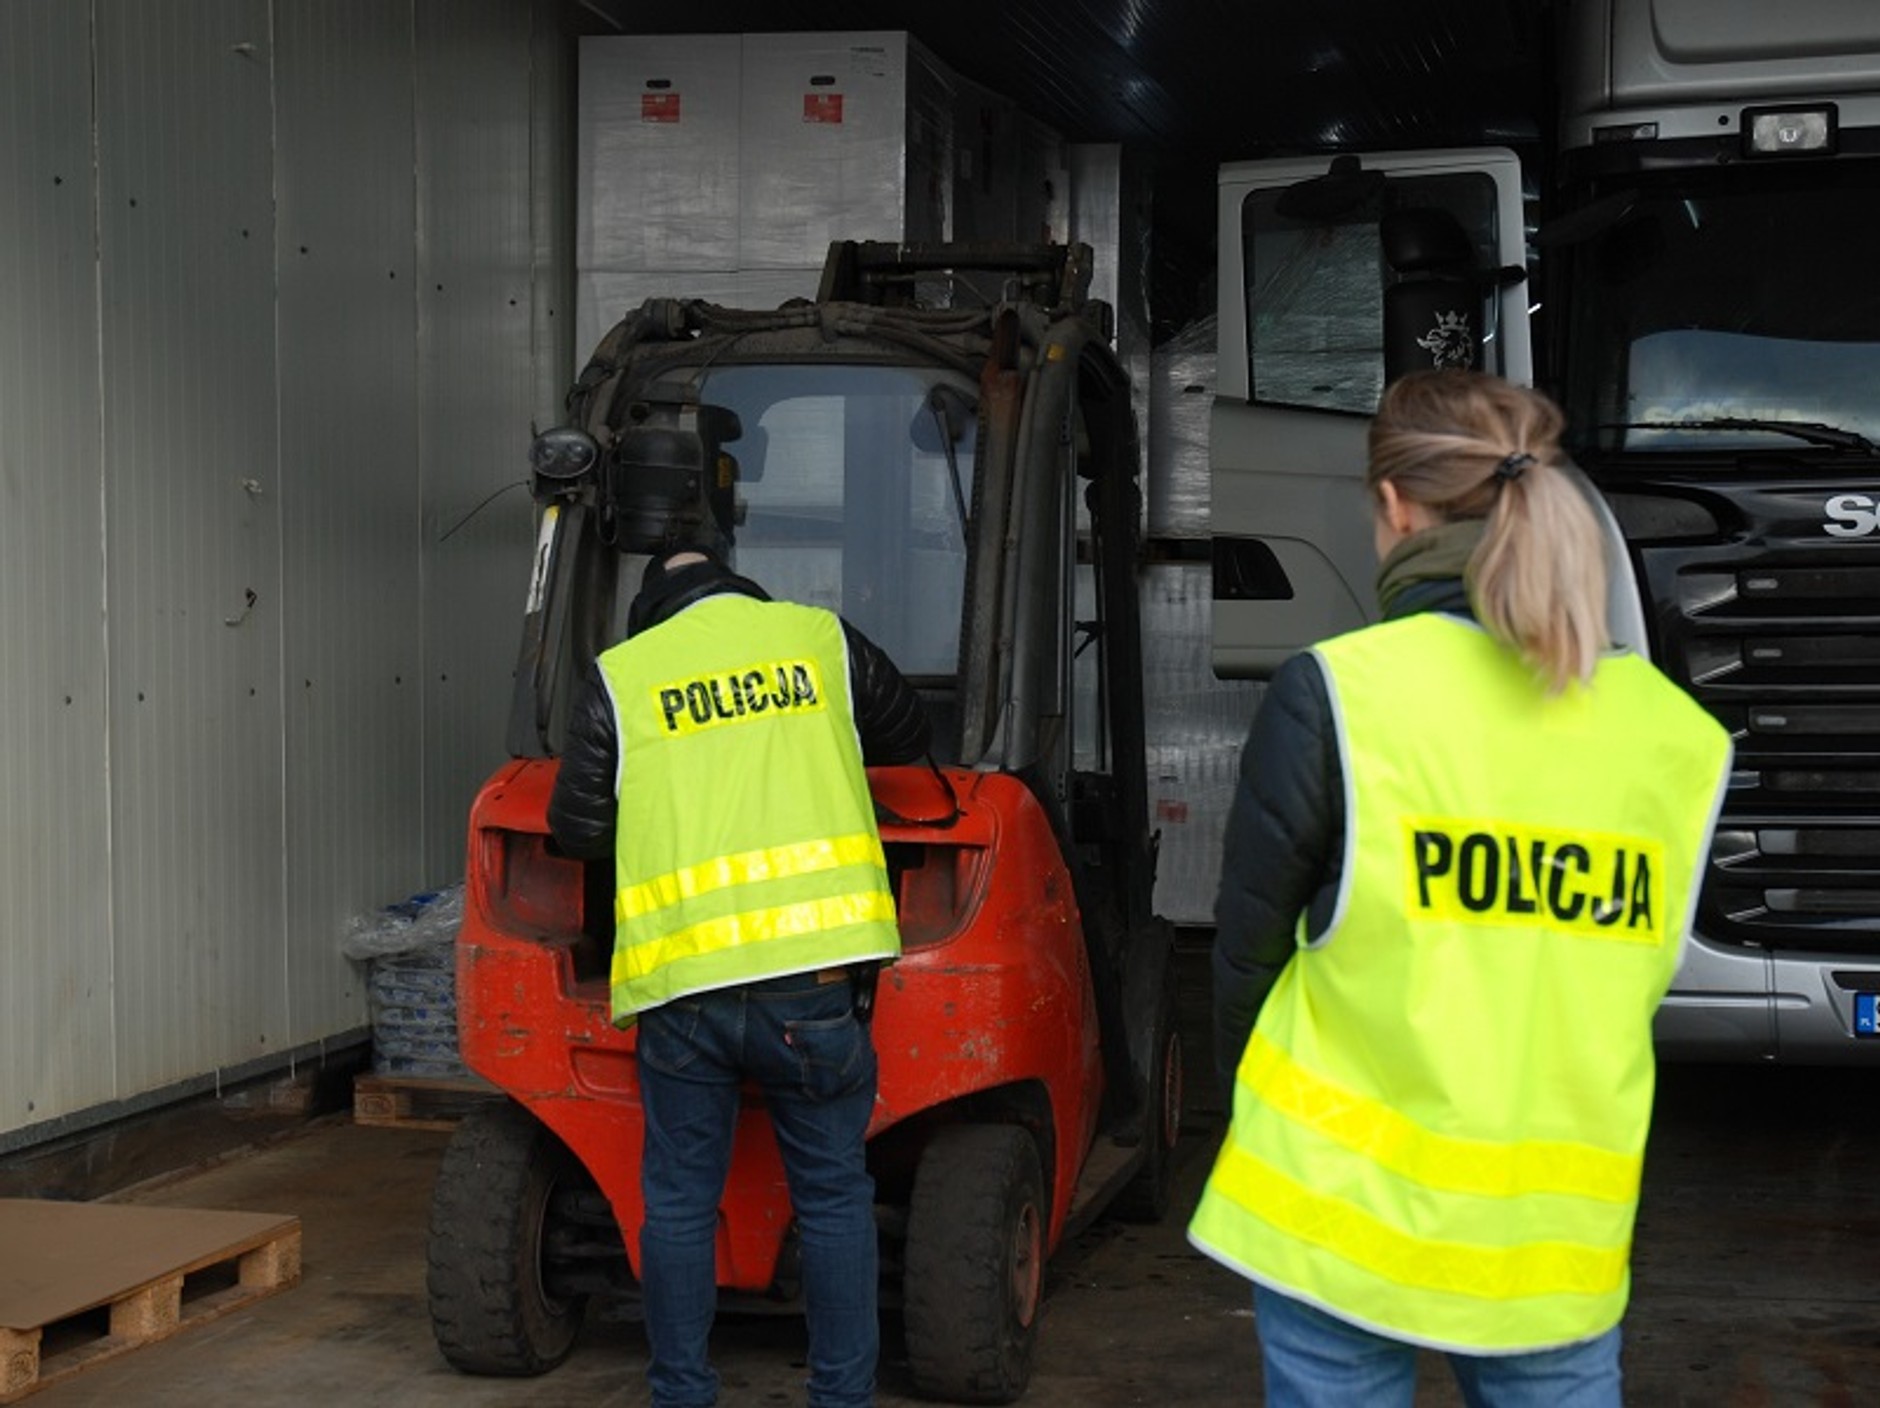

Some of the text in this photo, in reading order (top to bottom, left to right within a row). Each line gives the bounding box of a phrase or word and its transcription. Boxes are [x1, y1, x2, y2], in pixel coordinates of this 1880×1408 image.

[1822, 494, 1880, 537] S
[660, 665, 817, 731] POLICJA
[1414, 831, 1653, 930] POLICJA
